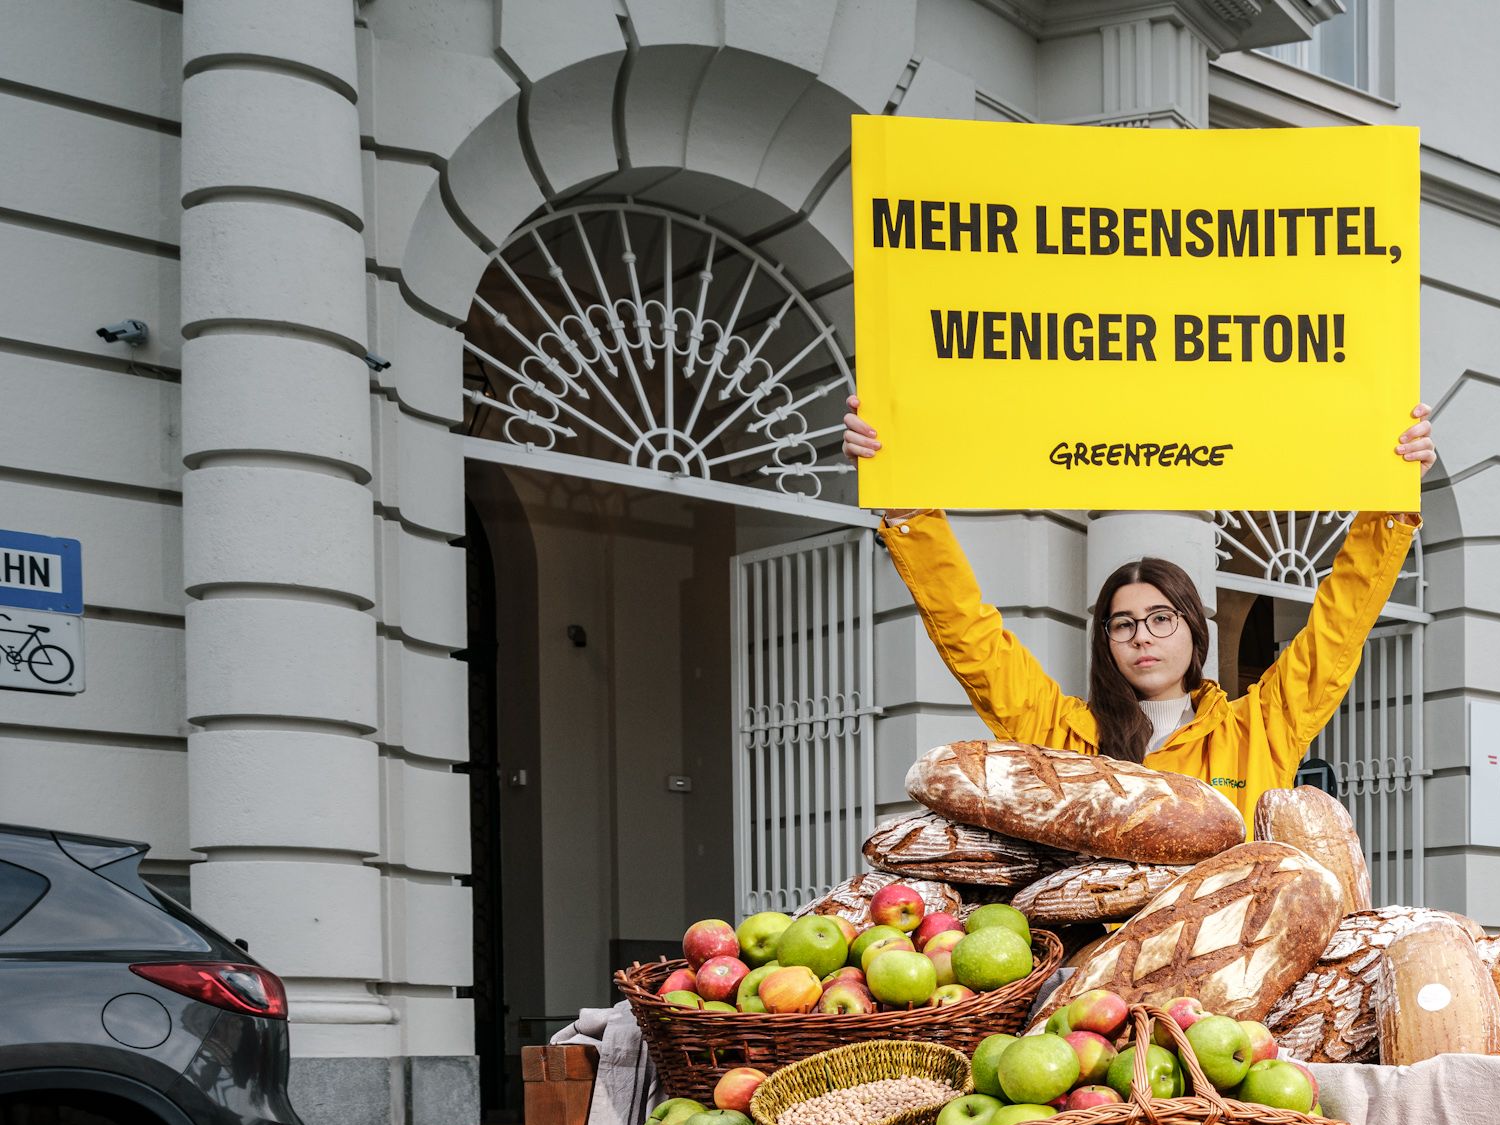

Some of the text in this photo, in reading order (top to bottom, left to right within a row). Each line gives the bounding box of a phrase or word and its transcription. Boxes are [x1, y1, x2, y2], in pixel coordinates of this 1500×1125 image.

[871, 197, 1402, 265] MEHR LEBENSMITTEL,
[930, 309, 1347, 363] WENIGER BETON!
[1048, 441, 1233, 470] GREENPEACE
[0, 552, 50, 587] HN
